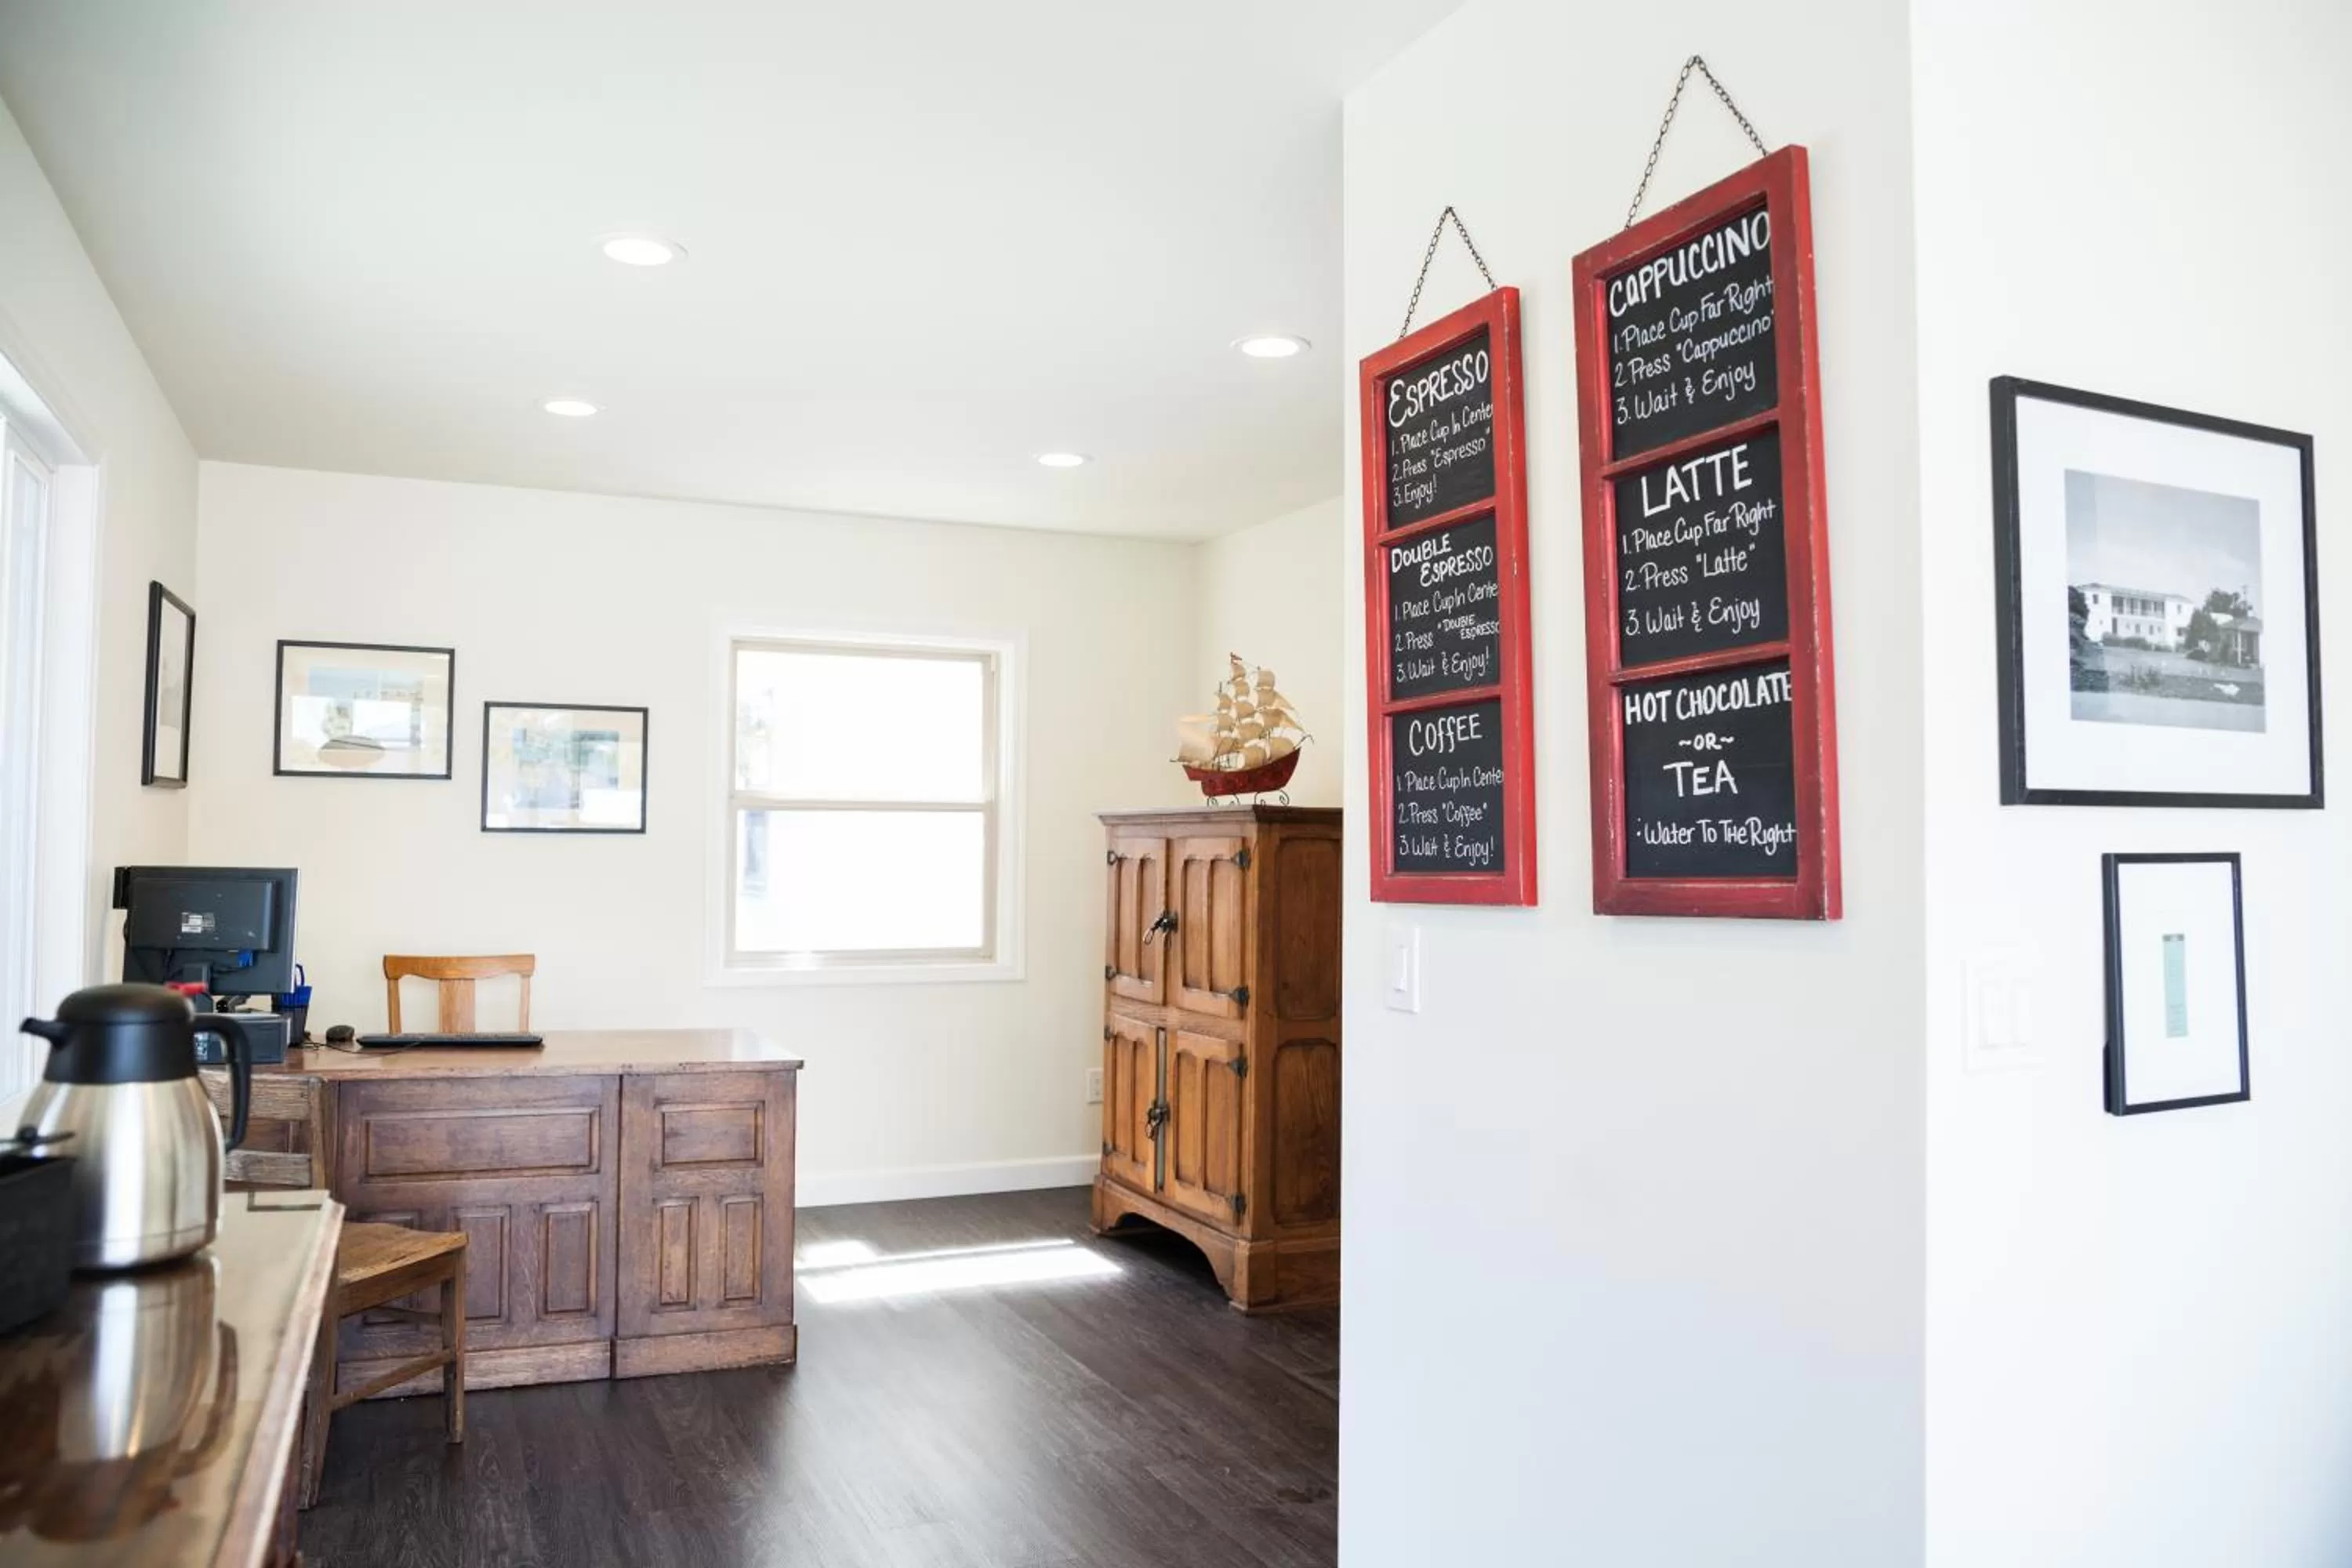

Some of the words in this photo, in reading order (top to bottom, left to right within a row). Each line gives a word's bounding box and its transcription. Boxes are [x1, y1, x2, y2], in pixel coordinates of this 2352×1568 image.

[1609, 210, 1771, 318] CAPPUCCINO
[1623, 321, 1666, 352] Place
[1669, 307, 1698, 334] Cup
[1700, 292, 1725, 323] Far
[1724, 274, 1773, 314] Right
[1388, 350, 1489, 427] ESPRESSO
[1628, 354, 1671, 385] Press
[1617, 397, 1632, 424] 3.
[1635, 382, 1678, 419] Wait
[1685, 377, 1695, 404] &
[1701, 361, 1756, 401] Enjoy
[1401, 430, 1428, 453] Place
[1430, 419, 1450, 443] Cup
[1452, 412, 1461, 435] In
[1403, 459, 1428, 479] Press
[1641, 443, 1752, 517] LATTE
[1404, 474, 1437, 509] Enjoy!
[1632, 528, 1673, 552] Place
[1674, 517, 1703, 546] Cup
[1704, 510, 1730, 537] Far
[1729, 498, 1777, 536] Right
[1392, 533, 1452, 573] DOUBLE
[1421, 546, 1494, 586] ESPRESSO
[1625, 569, 1641, 593] 2.
[1639, 561, 1688, 590] Press
[1403, 600, 1430, 619] Place
[1433, 590, 1455, 615] Cup
[1454, 587, 1465, 608] In
[1625, 608, 1641, 637] 3.
[1646, 605, 1684, 634] Wait
[1691, 601, 1702, 633] &
[1708, 596, 1760, 634] Enjoy
[1405, 631, 1434, 650] Press
[1408, 658, 1436, 681] Wait
[1451, 645, 1490, 681] Enjoy!
[1625, 689, 1671, 725] HOT
[1675, 670, 1792, 720] CHOCOLATE
[1404, 770, 1436, 793] Place
[1439, 766, 1458, 793] Cup
[1460, 768, 1472, 789] In
[1663, 759, 1738, 798] TEA
[1408, 802, 1439, 824] Press
[1412, 836, 1439, 856] Wait
[1454, 835, 1494, 866] Enjoy!
[1644, 820, 1696, 845] Water
[1696, 819, 1718, 843] To
[1745, 816, 1797, 856] Right
